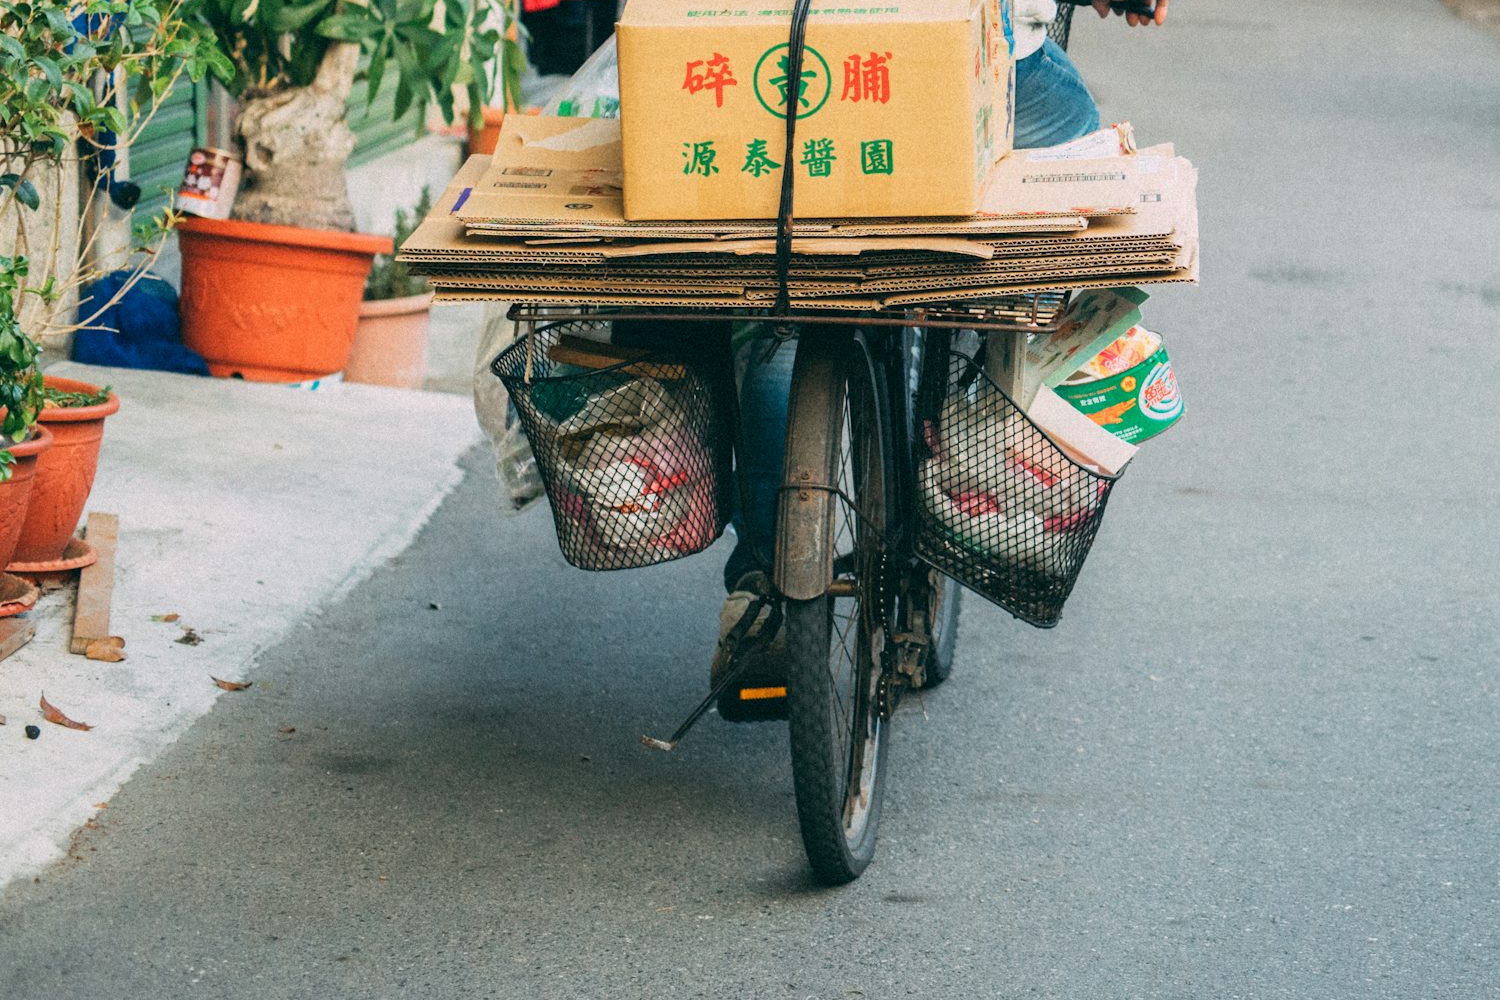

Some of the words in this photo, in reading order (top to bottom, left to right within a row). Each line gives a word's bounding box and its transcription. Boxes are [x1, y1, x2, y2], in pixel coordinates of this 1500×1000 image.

[682, 52, 737, 108] 碎
[841, 52, 893, 104] 脯
[682, 138, 894, 178] 源泰醬園
